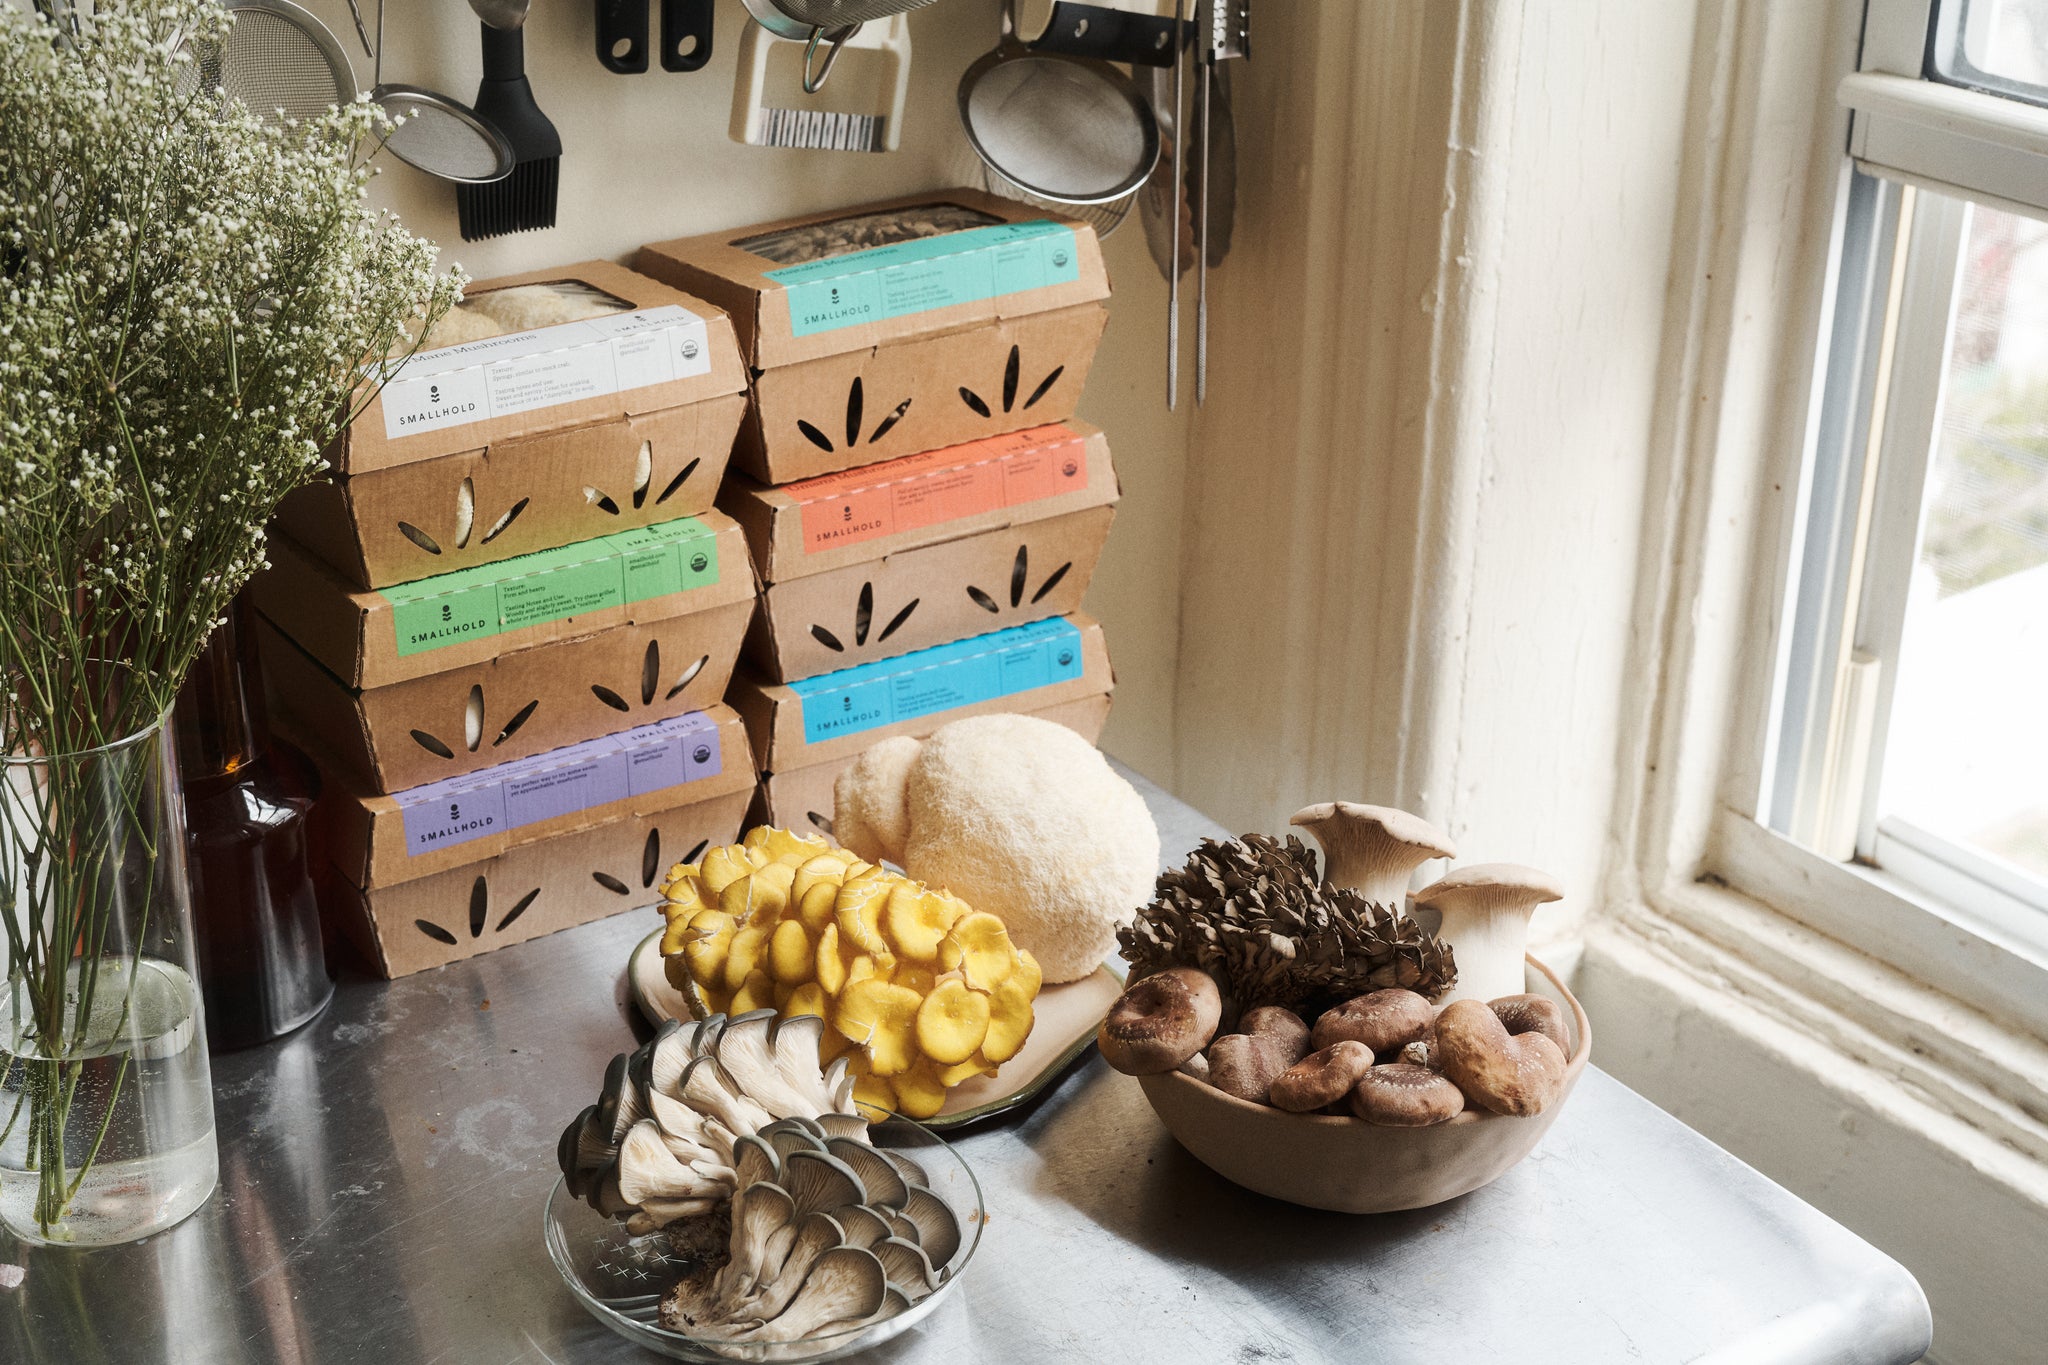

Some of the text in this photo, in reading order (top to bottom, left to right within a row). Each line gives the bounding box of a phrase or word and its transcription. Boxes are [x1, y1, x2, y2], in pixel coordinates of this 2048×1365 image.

[804, 304, 871, 325] SMALLHOLD
[412, 335, 537, 363] Mane Mushrooms
[399, 402, 476, 426] SMALLHOLD
[626, 527, 697, 547] SMALLHOLD
[816, 519, 883, 542] SMALLHOLD
[504, 584, 526, 593] Texture:
[504, 592, 517, 600] Firm
[529, 585, 546, 594] hearty
[505, 603, 525, 613] Tasting
[526, 599, 542, 608] Notes
[506, 610, 524, 619] Woody
[537, 603, 556, 612] slightly
[584, 592, 598, 600] them
[599, 588, 616, 597] grilled
[411, 620, 486, 644] SMALLHOLD
[631, 720, 699, 741] SMALLHOLD
[817, 709, 881, 732] SMALLHOLD
[420, 816, 494, 843] SMALLHOLD
